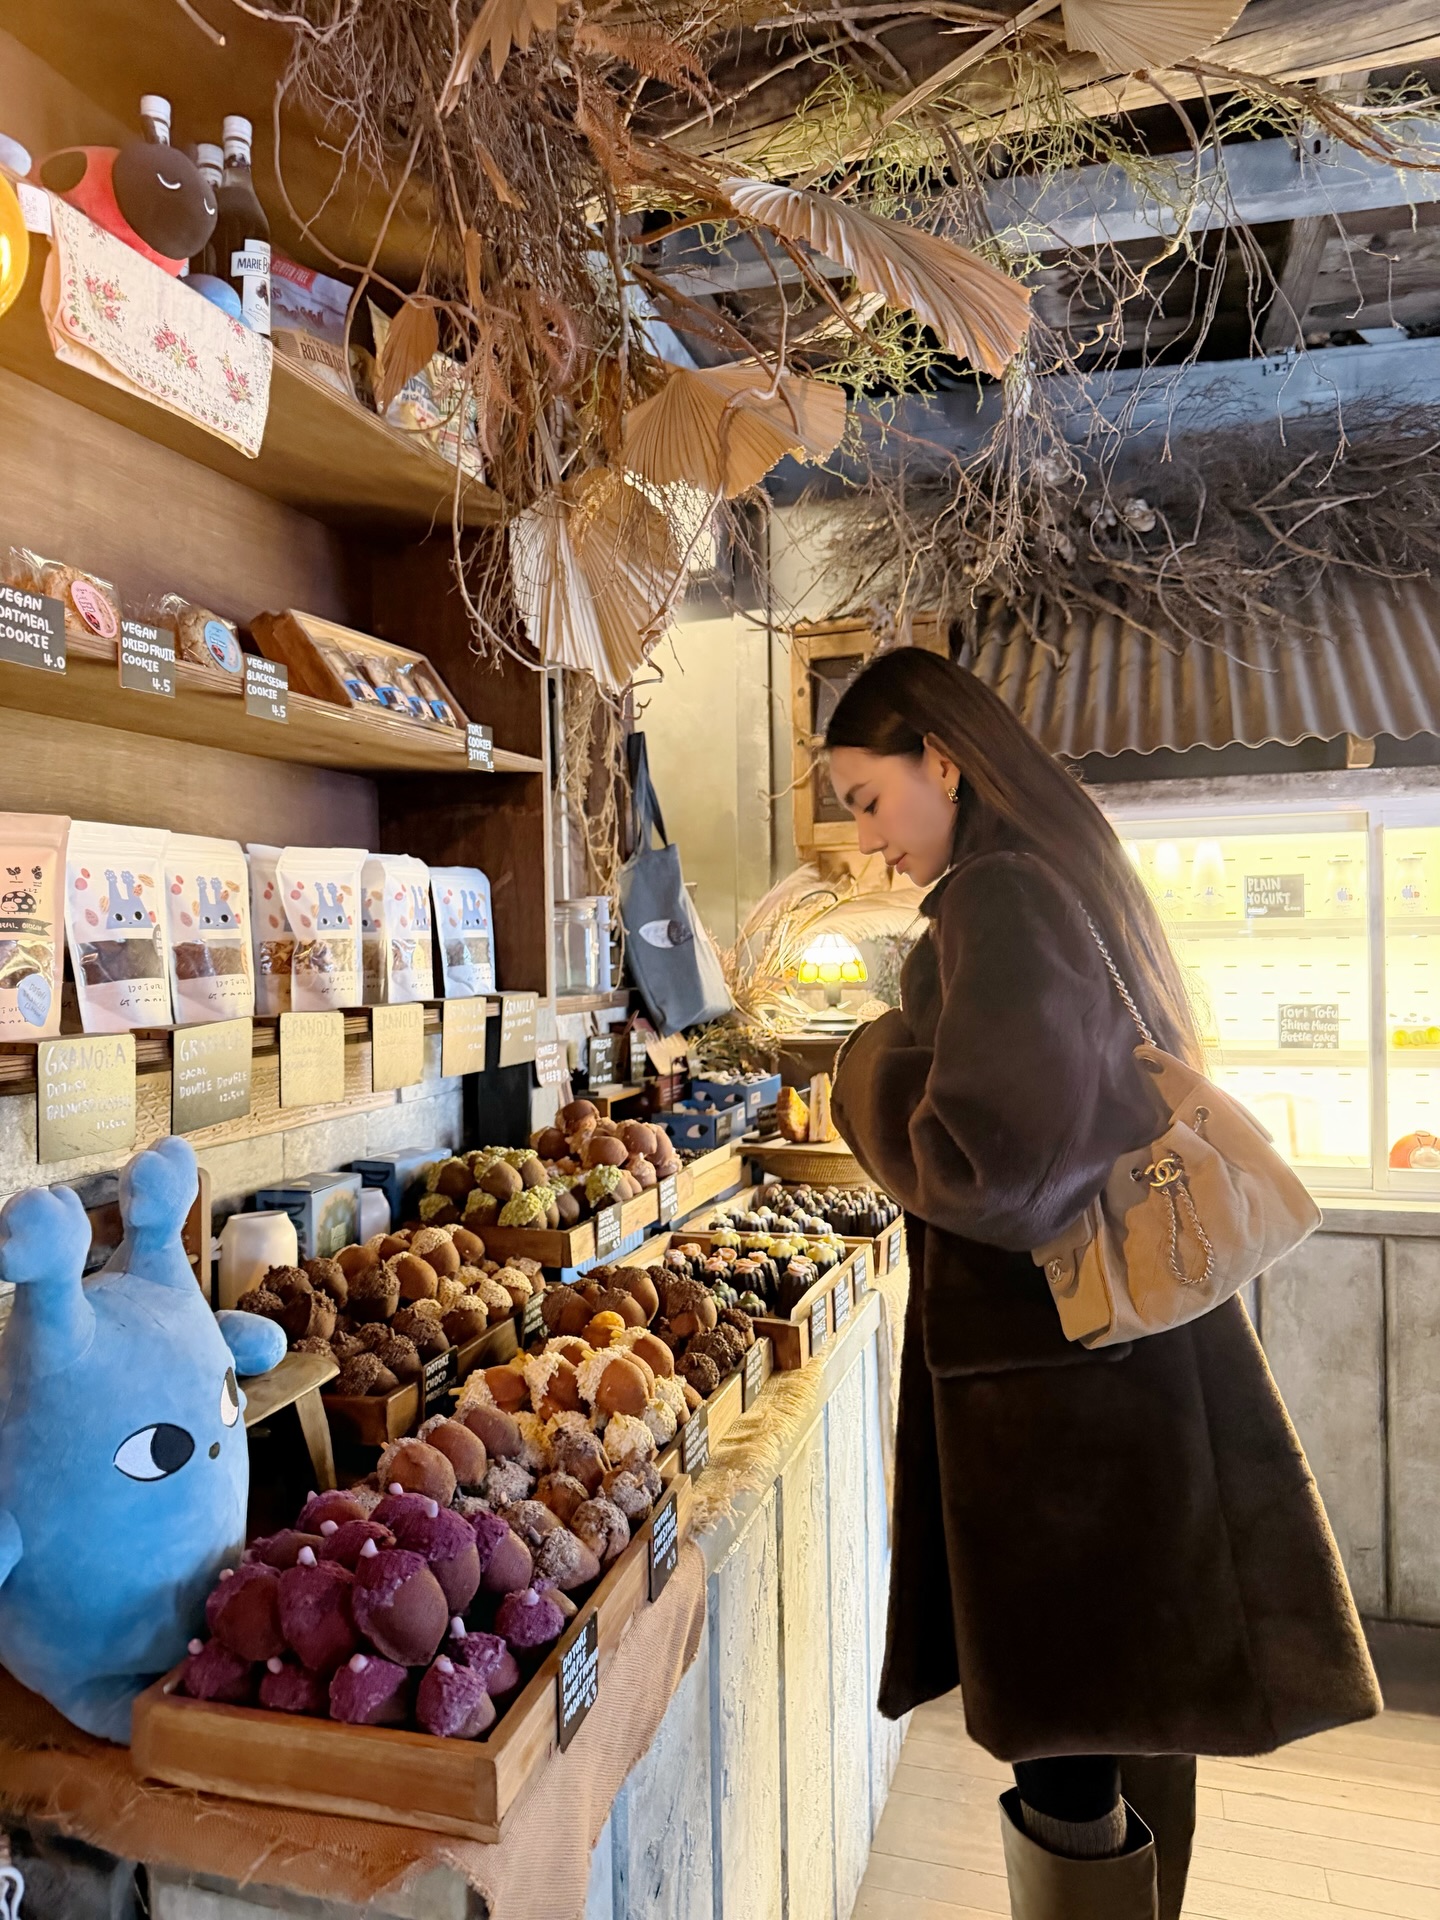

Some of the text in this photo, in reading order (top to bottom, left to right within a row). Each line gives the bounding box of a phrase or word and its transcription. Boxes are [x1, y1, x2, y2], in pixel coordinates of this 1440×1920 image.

[237, 257, 262, 271] MARIE
[0, 623, 49, 650] COOKIE
[121, 620, 157, 640] VEGAN
[122, 636, 176, 663] DRIED FRUITS
[43, 652, 66, 669] 4.0
[122, 652, 160, 673] COOKIE
[246, 656, 275, 674] VEGAN
[152, 677, 171, 692] 4.5
[246, 684, 278, 700] COOKIE
[271, 704, 287, 718] 4.5
[1247, 876, 1281, 892] PLAIN
[1247, 891, 1291, 906] YOGURT
[1280, 1004, 1338, 1019] Tori Tofu
[1281, 1019, 1310, 1031] Shine
[1280, 1030, 1337, 1043] Bottle cake
[425, 1353, 450, 1378] DOTORI
[425, 1370, 447, 1393] CHOCO
[654, 1501, 672, 1537] DOTORI
[666, 1547, 677, 1570] 4.3
[563, 1625, 587, 1674] DOTORI
[563, 1646, 587, 1693] PURPLE
